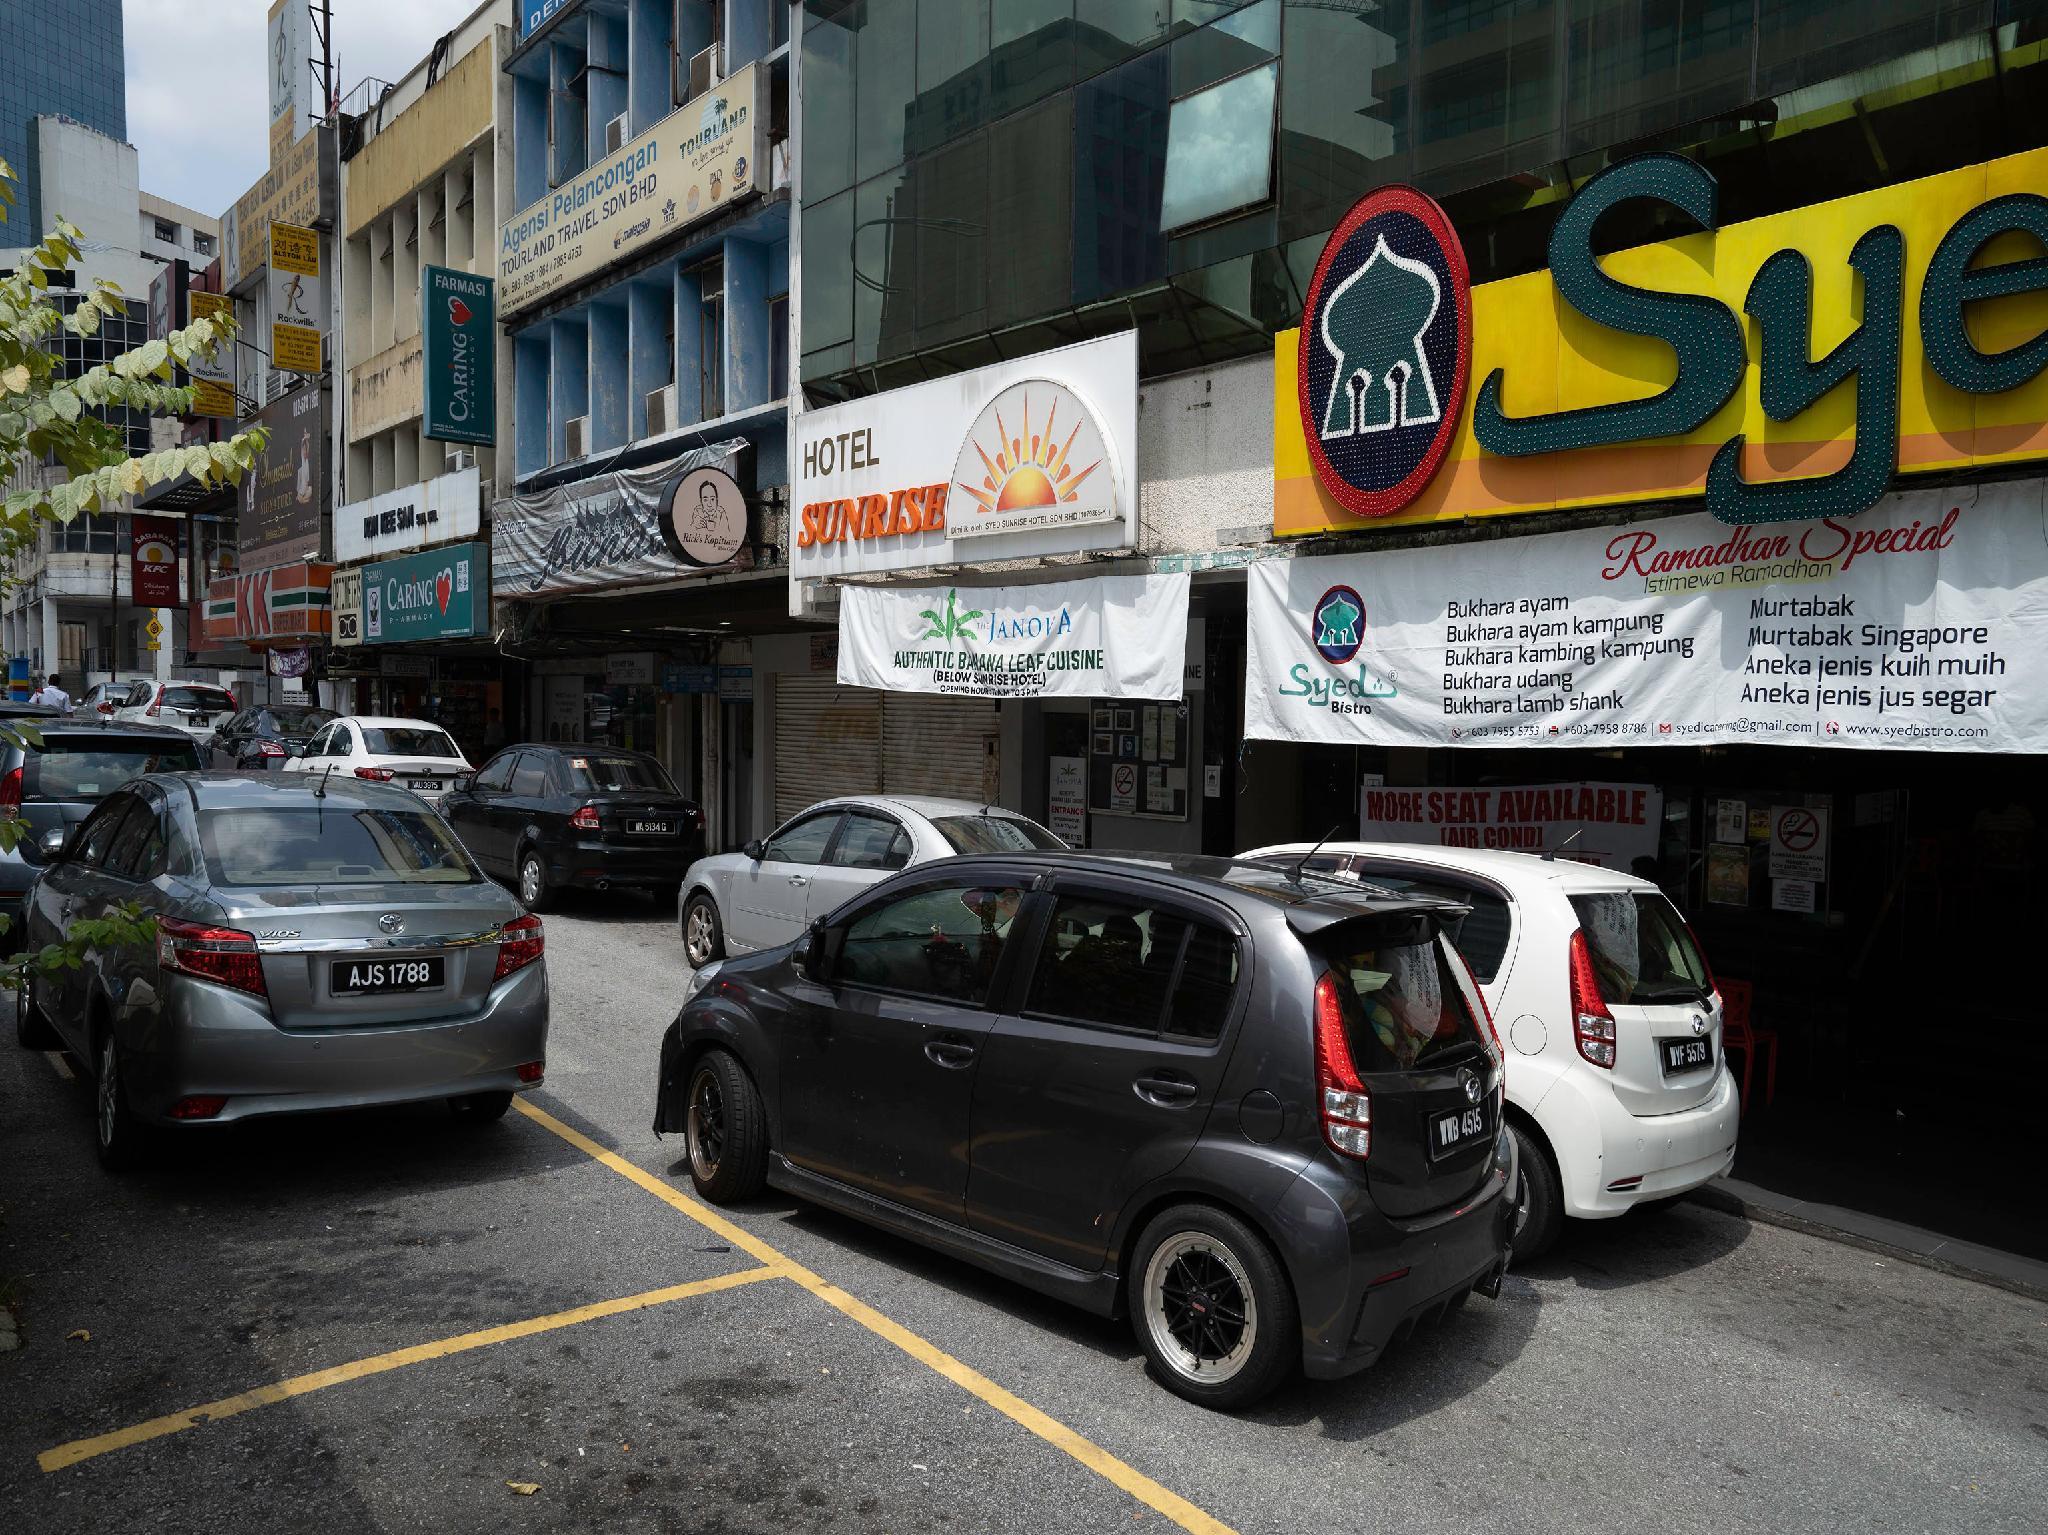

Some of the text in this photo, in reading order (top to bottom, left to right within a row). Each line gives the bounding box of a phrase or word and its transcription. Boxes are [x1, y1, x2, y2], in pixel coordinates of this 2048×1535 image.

[680, 106, 747, 159] TOURLAND
[502, 141, 657, 254] Agensi Pelancongan
[502, 174, 657, 277] TOURLAND TRAVEL SDN BHD
[435, 274, 486, 297] FARMASI
[278, 313, 315, 327] Rockwills
[196, 367, 229, 379] Rockwills
[804, 427, 880, 480] HOTEL
[798, 482, 949, 548] SUNRISE
[985, 522, 1000, 530] SYED
[1002, 518, 1028, 528] SUNRISE
[1029, 516, 1048, 525] HOTEL
[1050, 514, 1063, 523] SDN
[1065, 512, 1077, 521] BHD
[135, 532, 176, 546] SARAPAN
[682, 532, 702, 544] Rick's
[1602, 507, 1960, 582] Ramadhan Special
[143, 564, 169, 574] KFC
[1644, 558, 1833, 595] Istimewa Ramadhan
[387, 573, 433, 610] CARING
[237, 573, 271, 637] KK
[1447, 596, 1569, 619] Bukhara ayam
[1750, 594, 1855, 619] Murtabak
[1447, 613, 1665, 644] Bukhara ayam kampung
[1748, 624, 1988, 653] Murtabak Singapore
[894, 649, 1104, 673] AUTHENTIC BANANA LEAF CUISINE
[1445, 636, 1695, 667] Bukhara kambing kampung
[933, 669, 1047, 687] (BELOW SUNRISE HOTEL)
[1443, 669, 1573, 692] Bukhara udang
[1745, 652, 2006, 684] Aneka jenis kuih muih
[940, 684, 970, 694] OPENING
[1279, 663, 1397, 707] Syed
[1331, 701, 1372, 714] Bistro
[1443, 690, 1624, 714] Bukhara lamb shank
[1741, 682, 1997, 715] Aneka jenis jus segar
[1492, 725, 1515, 737] 7955
[1517, 725, 1540, 736] 5753
[1563, 723, 1619, 736] +603-7958
[1621, 722, 1647, 735] 8786
[1846, 719, 1989, 738] www.syedbistro.com
[1051, 805, 1085, 816] ENTRANCE
[1367, 788, 1647, 825] MORE SEAT AVAILABLE
[259, 930, 301, 938] VIOS
[349, 963, 430, 988] AJS 1788
[1686, 1042, 1706, 1063] 5579
[1440, 1107, 1482, 1145] WWB 4515
